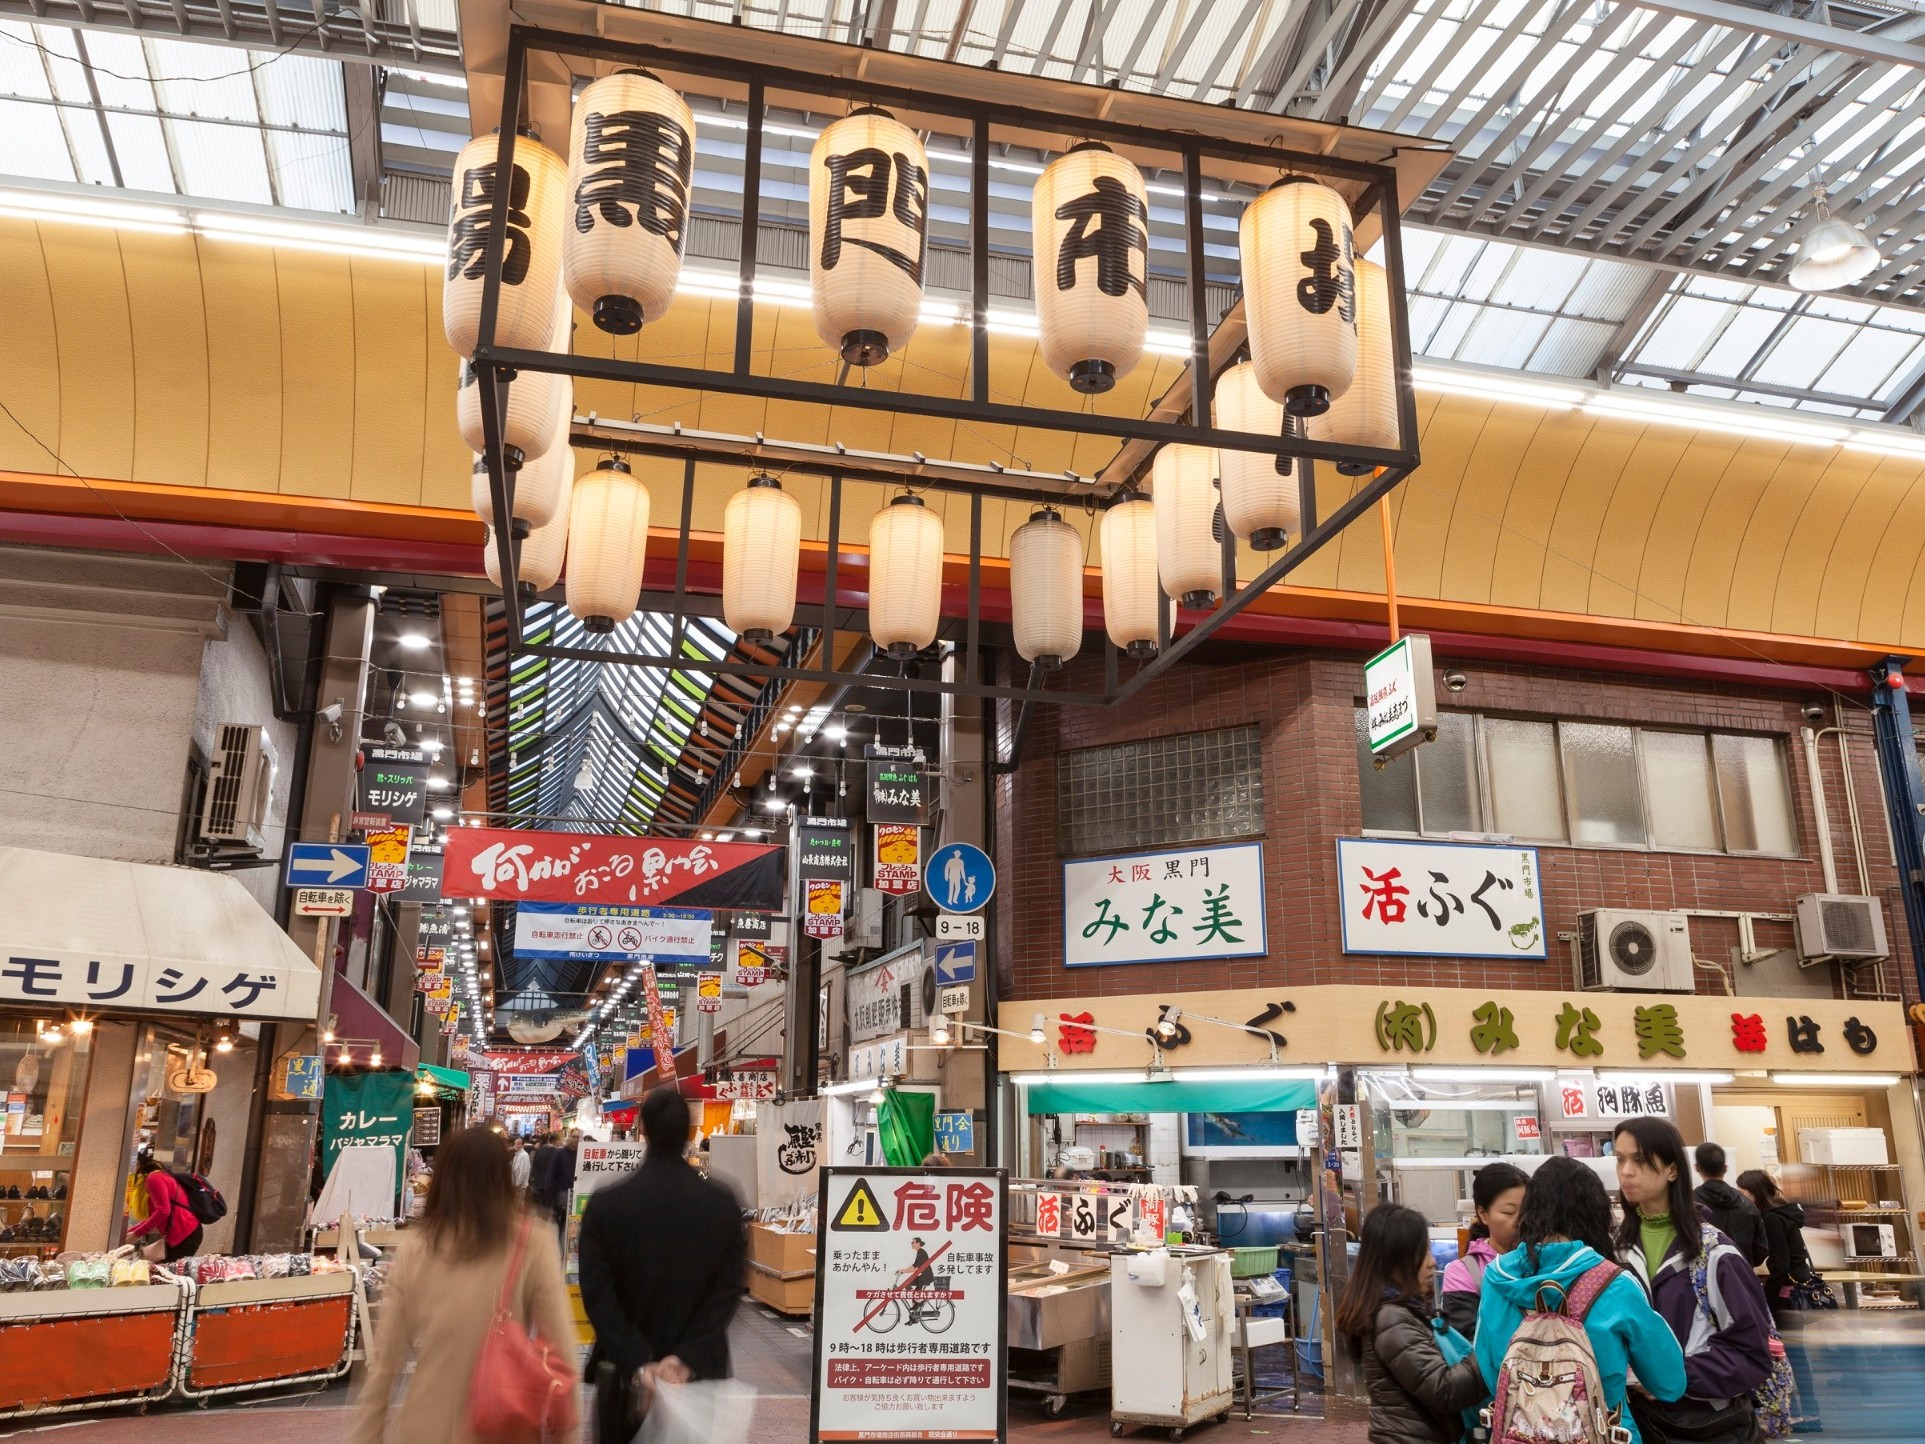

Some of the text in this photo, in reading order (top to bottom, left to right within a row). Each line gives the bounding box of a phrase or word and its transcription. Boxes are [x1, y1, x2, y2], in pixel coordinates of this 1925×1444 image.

[372, 748, 423, 761] 黒門市場
[368, 790, 417, 807] モリシゲ
[807, 818, 847, 827] 黒門市場
[879, 826, 905, 836] クロモン
[411, 845, 441, 853] 門市場
[881, 863, 913, 871] フレッシュ
[369, 870, 403, 879] TAMP
[878, 870, 917, 879] STAMP
[1520, 852, 1533, 900] 黒門市場
[404, 876, 439, 889] ジャマラマ
[878, 880, 918, 889] 加盟店
[299, 891, 351, 905] 自転車を除く
[1359, 866, 1514, 932] 活ふぐ
[577, 906, 651, 917] 歩行者専用道路
[1082, 883, 1246, 947] みな美
[531, 930, 583, 940] 自転車走行禁止
[807, 927, 841, 935] 加盟店
[644, 935, 695, 944] バイク通行禁止
[1, 957, 277, 1010] モリシゲ
[1058, 1001, 1296, 1055] 活ふぐ
[1730, 1011, 1878, 1056] 活はも
[339, 1110, 398, 1130] カレー
[934, 1115, 971, 1133] 黒門会
[1339, 1108, 1348, 1146] 入荷しました
[941, 1134, 960, 1151] 通り
[583, 1148, 643, 1160] 自転車から降りて
[582, 1161, 640, 1172] 通行して下さい
[892, 1181, 995, 1233] 危険
[1038, 1194, 1132, 1237] 活ふぐ
[833, 1250, 880, 1261] 乗ったまま
[947, 1252, 994, 1263] 自転車事故
[833, 1262, 887, 1273] あかんやん！
[937, 1264, 994, 1275] 多発してます
[866, 1290, 953, 1299] ケガさせて責任とれますか？
[835, 1362, 985, 1372] 法律上、アーケード内は歩行者専用道路です
[834, 1375, 985, 1385] バイク・自転車は必ず降りて通行して下さい
[842, 1393, 976, 1403] お客様が気持ち良くお買い物出来ますよう
[874, 1402, 945, 1412] ご協力お願い致します
